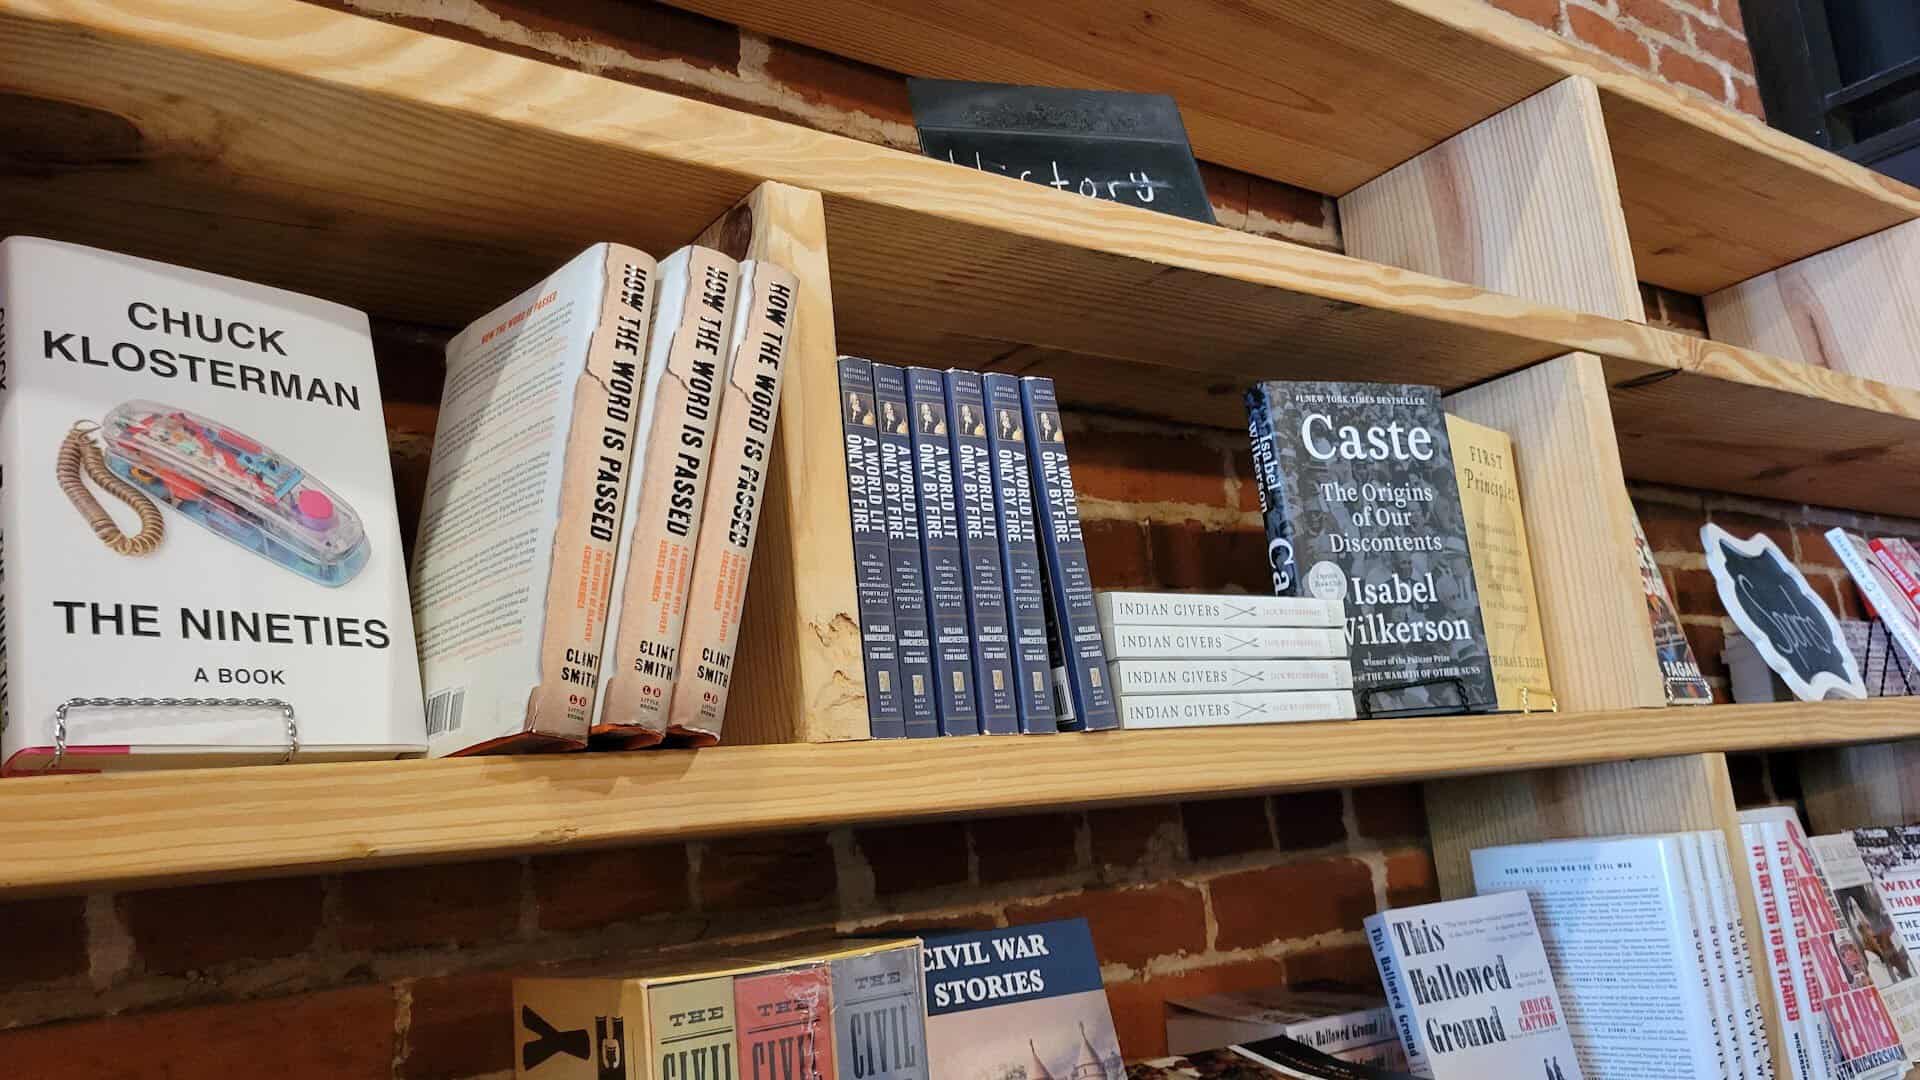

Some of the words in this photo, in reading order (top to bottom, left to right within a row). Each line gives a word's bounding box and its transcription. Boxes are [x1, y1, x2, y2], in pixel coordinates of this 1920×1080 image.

[621, 264, 647, 312] HOW
[702, 265, 729, 314] HOW
[765, 281, 791, 329] HOW
[127, 302, 288, 356] CHUCK
[615, 315, 641, 355] THE
[695, 315, 722, 356] THE
[758, 331, 783, 371] THE
[44, 330, 361, 410] KLOSTERMAN
[607, 360, 636, 423] WORD
[686, 360, 715, 421] WORD
[1304, 393, 1325, 403] NEW
[1326, 393, 1349, 404] YORK
[1350, 394, 1376, 405] TIMES
[1376, 396, 1425, 406] BESTSELLER
[748, 374, 776, 435] WORD
[603, 427, 627, 451] IS
[681, 424, 705, 449] IS
[863, 436, 878, 447] A
[1301, 413, 1434, 461] Caste
[744, 437, 765, 463] IS
[847, 434, 865, 472] ONLY
[881, 442, 899, 480] ONLY
[897, 445, 911, 456] A
[919, 443, 937, 480] ONLY
[935, 445, 950, 456] A
[959, 444, 977, 480] ONLY
[975, 446, 989, 457] A
[1013, 451, 1026, 462] A
[1055, 452, 1069, 462] A
[1260, 433, 1281, 492] Isabel
[1468, 445, 1503, 470] FIRST
[865, 452, 883, 505] WORLD
[998, 448, 1015, 484] ONLY
[1042, 451, 1060, 486] ONLY
[667, 452, 701, 537] PASSED
[850, 475, 867, 495] BY
[885, 482, 901, 503] BY
[898, 460, 917, 513] WORLD
[922, 482, 939, 503] BY
[937, 460, 955, 512] WORLD
[963, 483, 979, 503] BY
[976, 461, 994, 512] WORLD
[1002, 487, 1018, 507] BY
[1014, 465, 1032, 516] WORLD
[1048, 488, 1063, 507] BY
[1058, 465, 1078, 516] WORLD
[1320, 482, 1359, 502] The
[1361, 482, 1434, 508] Origins
[1464, 467, 1516, 505] Principles
[590, 456, 622, 542] PASSED
[852, 498, 870, 534] FIRE
[869, 509, 887, 534] LIT
[887, 506, 905, 540] FIRE
[903, 516, 920, 540] LIT
[925, 506, 944, 540] FIRE
[942, 516, 958, 540] LIT
[965, 506, 983, 540] FIRE
[982, 516, 997, 539] LIT
[1005, 510, 1022, 543] FIRE
[1052, 510, 1070, 543] FIRE
[1352, 506, 1373, 527] of
[1376, 508, 1413, 528] Our
[1020, 520, 1036, 543] LIT
[1067, 519, 1083, 542] LIT
[1329, 533, 1443, 554] Discontents
[1351, 572, 1439, 606] Isabel
[1119, 602, 1169, 616] INDIAN
[1173, 603, 1221, 617] GIVERS
[1737, 573, 1832, 671] Sports
[53, 600, 161, 636] THE
[181, 607, 391, 648] NINETIES
[639, 640, 676, 662] CLINT
[1121, 634, 1171, 649] INDIAN
[1175, 635, 1223, 649] GIVERS
[566, 648, 599, 669] CLINT
[634, 658, 674, 681] SMITH
[702, 648, 731, 669] CLINT
[1362, 657, 1386, 667] Winner
[1387, 656, 1395, 665] of
[1394, 656, 1406, 665] the
[1433, 654, 1451, 663] Prize
[1663, 660, 1702, 678] FAGAN
[194, 667, 209, 683] A
[218, 668, 286, 685] BOOK
[560, 667, 598, 689] SMITH
[696, 665, 729, 689] SMITH
[1127, 671, 1177, 684] INDIAN
[1181, 670, 1229, 683] GIVERS
[1366, 671, 1384, 681] THE
[1384, 669, 1420, 681] WARMTH
[1420, 669, 1431, 679] OF
[1432, 667, 1461, 678] OTHER
[1461, 665, 1481, 675] SUNS
[1129, 704, 1179, 720] INDIAN
[1184, 703, 1231, 718] GIVERS
[1536, 865, 1559, 874] SOUTH
[1594, 863, 1614, 871] CIVIL
[1758, 873, 1780, 925] BETTER
[1782, 868, 1803, 918] BETTER
[1793, 921, 1808, 939] TO
[1897, 919, 1920, 930] THE
[1393, 918, 1446, 957] This
[1769, 929, 1785, 946] TO
[923, 941, 992, 973] CIVIL
[991, 934, 1050, 962] WAR
[1773, 948, 1789, 967] BE
[1798, 941, 1812, 960] BE
[855, 971, 902, 991] THE
[934, 968, 1046, 1008] STORIES
[1371, 927, 1385, 953] This
[1380, 955, 1405, 1010] Hallowed
[1398, 1014, 1421, 1058] Ground
[1408, 954, 1512, 1006] Hallowed
[1801, 960, 1823, 1013] FEARED
[1519, 995, 1554, 1015] BRUCE
[1777, 967, 1800, 1022] FEARED
[669, 1005, 725, 1027] THE
[756, 999, 810, 1018] THE
[1518, 1010, 1558, 1032] CATTON
[850, 1005, 917, 1080] CIVIL
[1316, 1024, 1350, 1047] Hallowed
[1425, 1006, 1507, 1055] Ground
